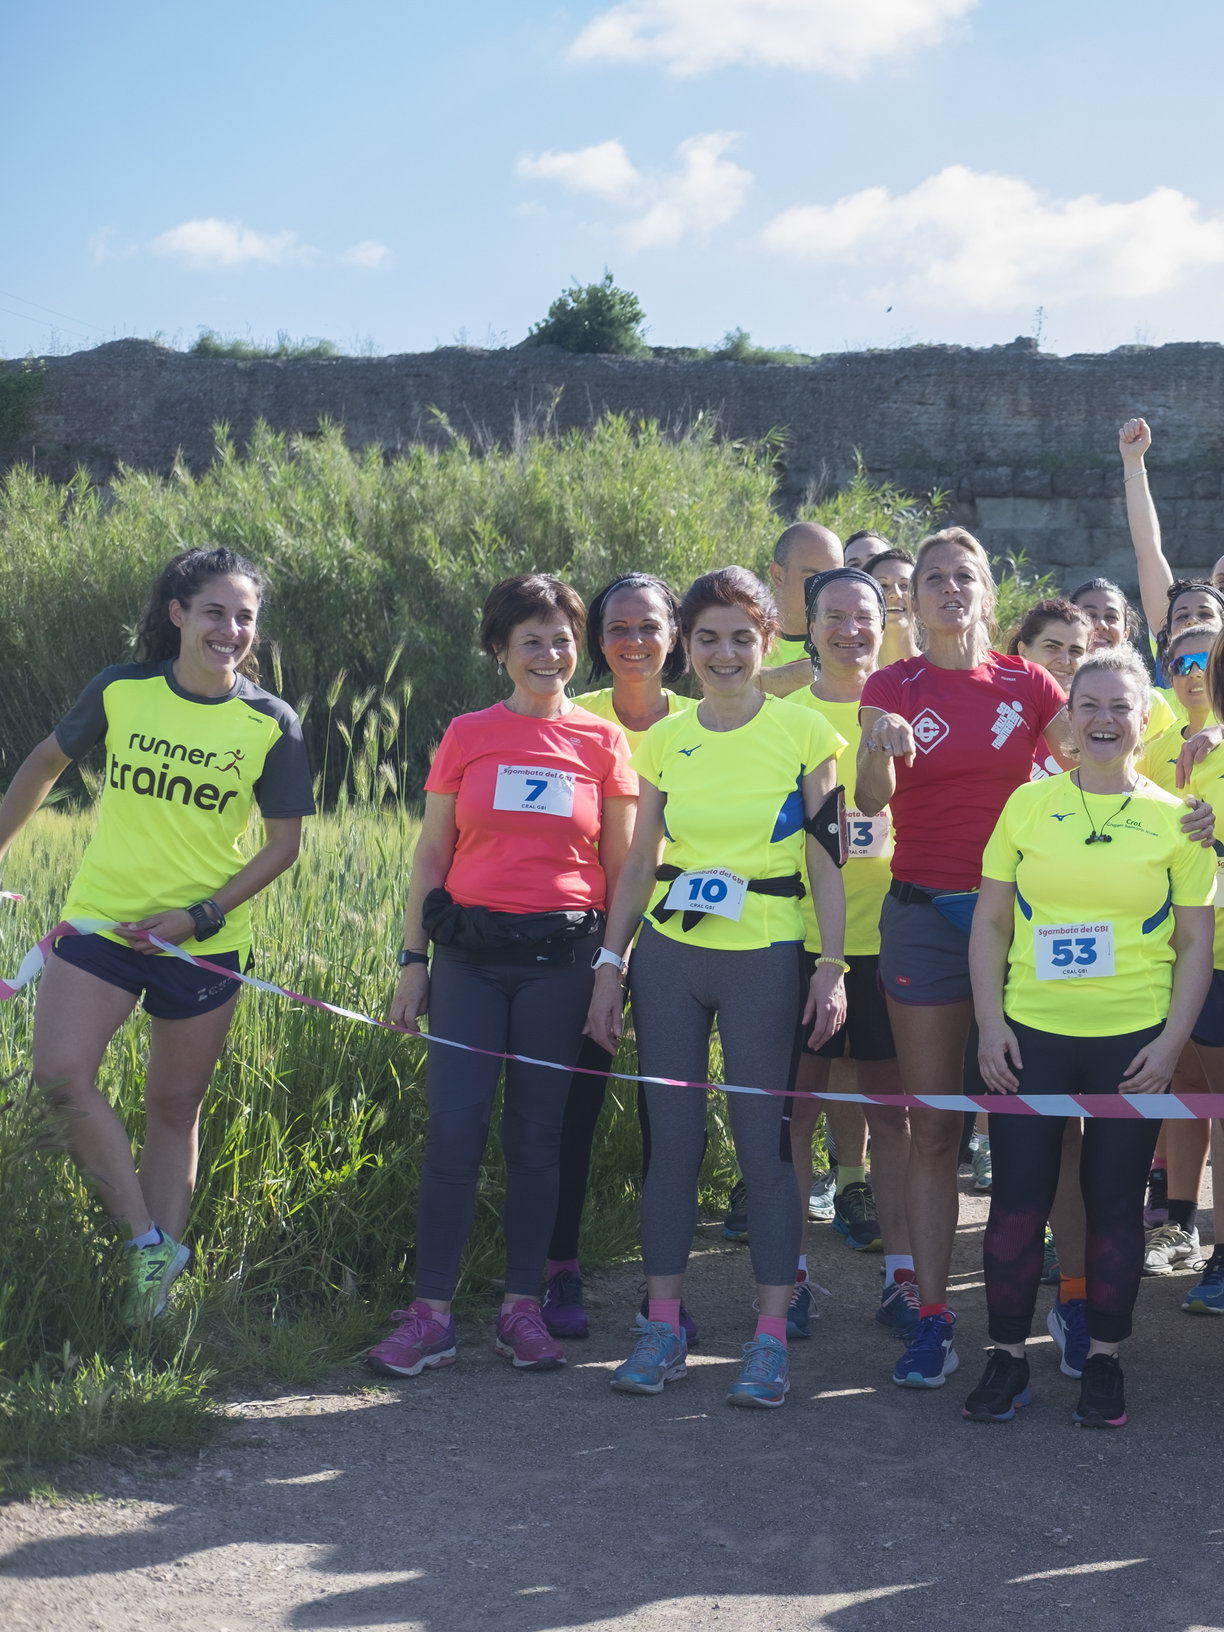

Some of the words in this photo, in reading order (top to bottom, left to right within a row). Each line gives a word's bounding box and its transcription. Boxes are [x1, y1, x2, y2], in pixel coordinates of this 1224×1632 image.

[129, 733, 217, 768] runner
[110, 753, 238, 814] trainer
[503, 768, 544, 776] Sgambata
[524, 779, 548, 802] 7
[719, 869, 732, 878] del
[732, 875, 745, 886] GBI
[688, 878, 728, 903] 10
[1038, 926, 1079, 937] Sgambata
[1094, 925, 1109, 933] GBI
[1050, 937, 1097, 967] 53
